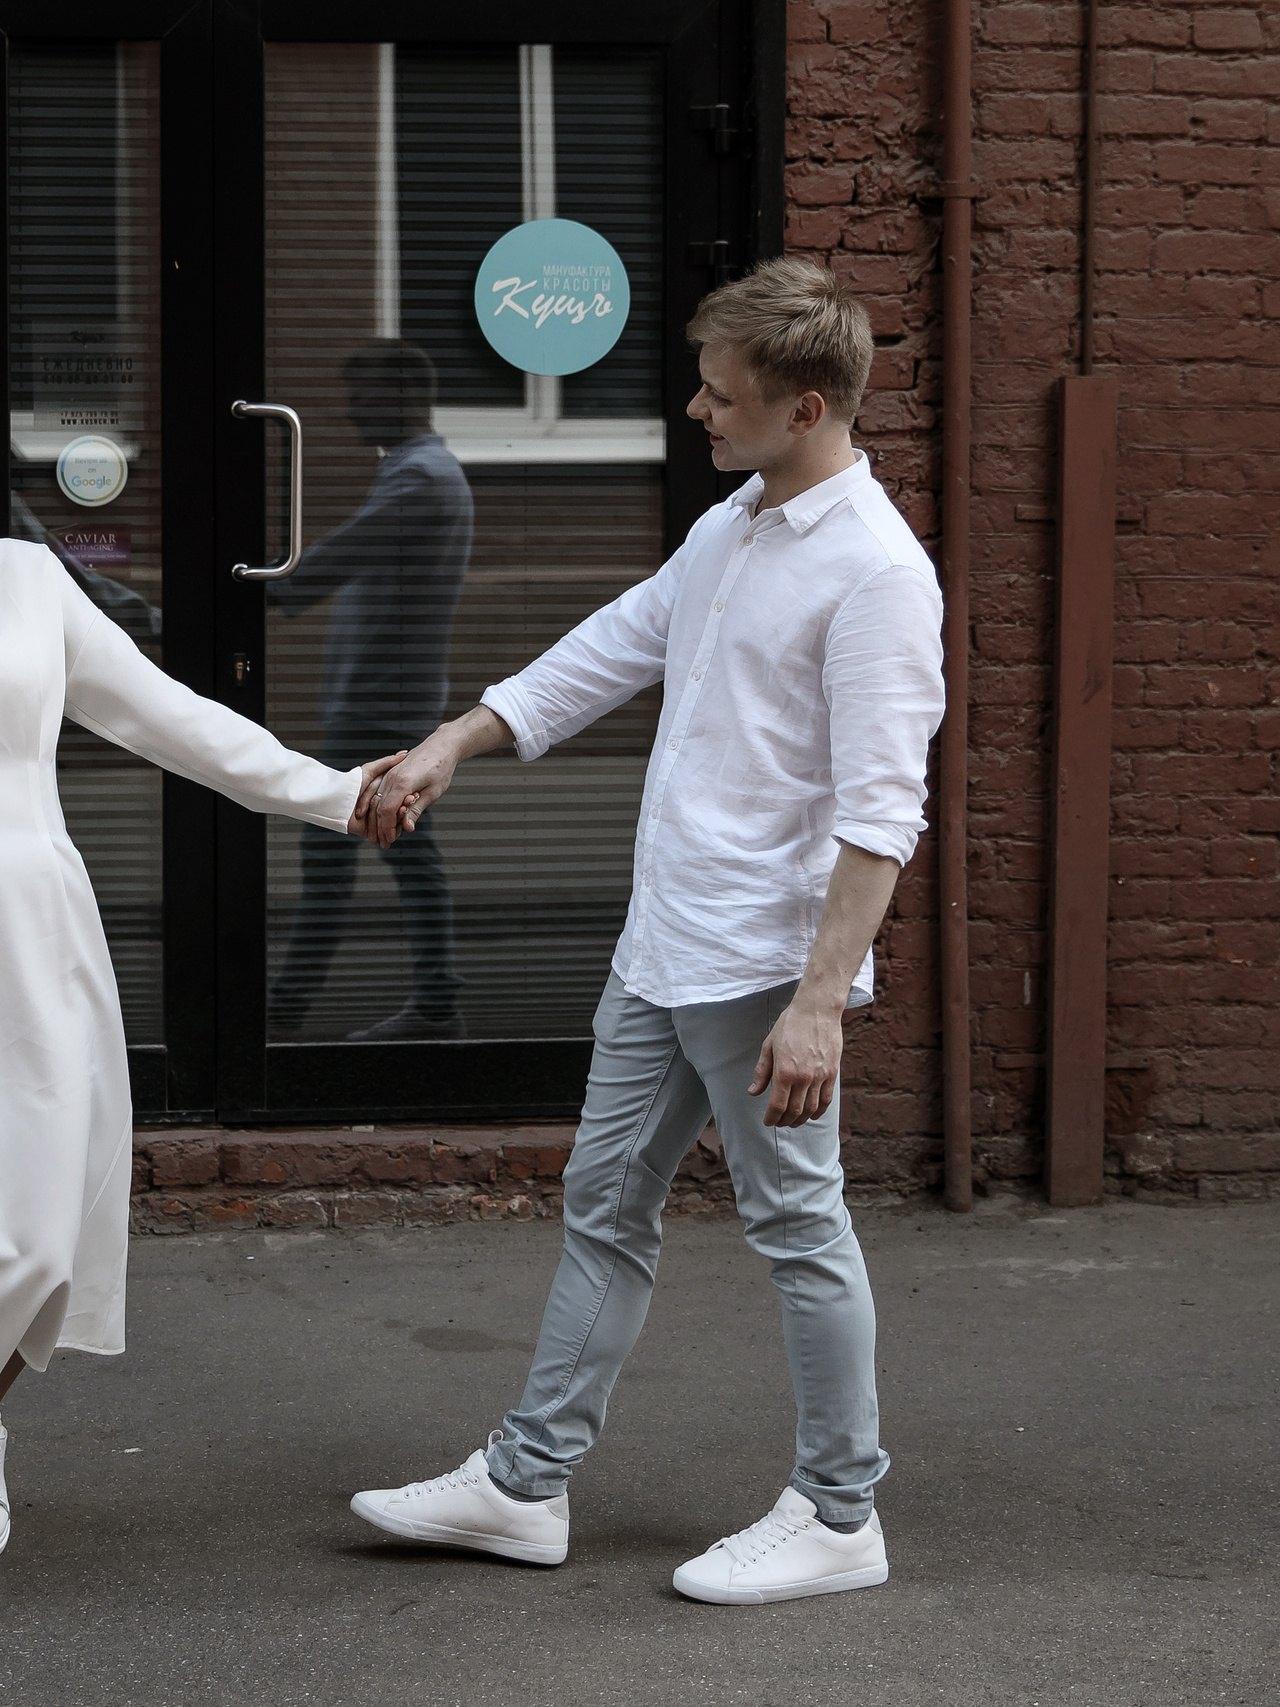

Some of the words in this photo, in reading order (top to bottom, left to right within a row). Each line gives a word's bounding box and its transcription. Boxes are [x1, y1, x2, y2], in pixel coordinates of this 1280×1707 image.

[542, 265, 611, 277] МАНУФАКТУРА
[543, 278, 611, 292] КРАСОТЫ
[43, 357, 133, 371] ЕЖЕДНЕВНО
[71, 475, 112, 489] Google
[65, 533, 116, 544] CAVIAR
